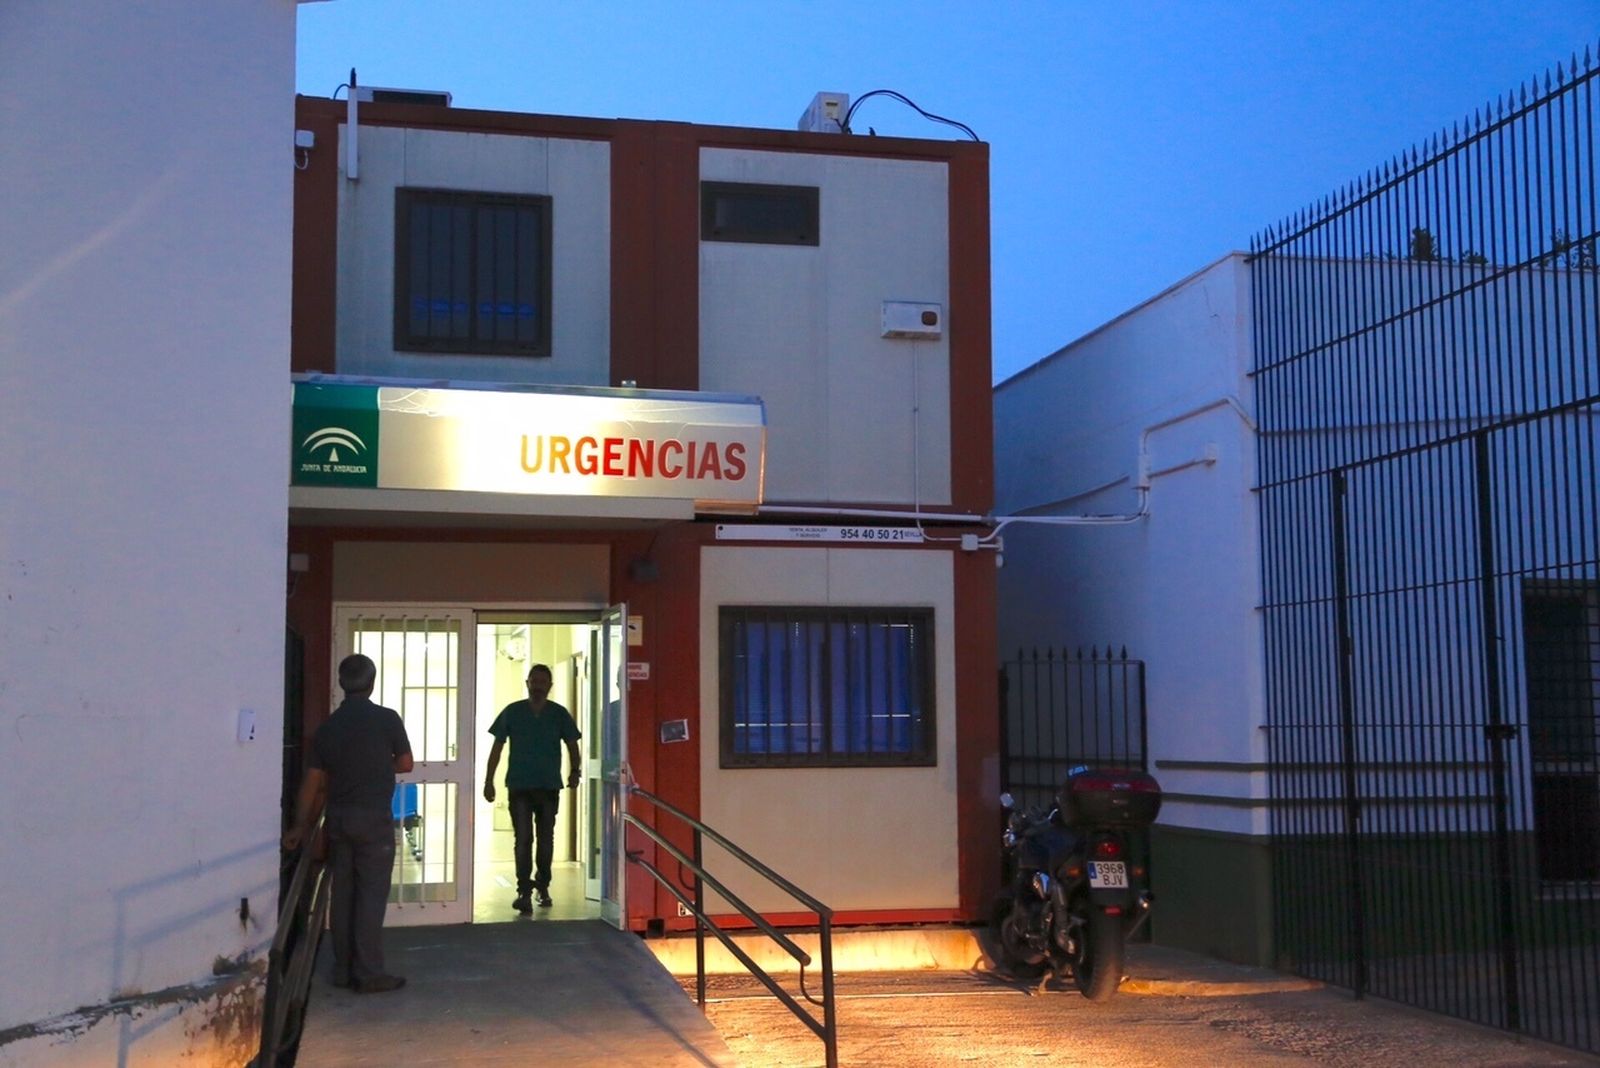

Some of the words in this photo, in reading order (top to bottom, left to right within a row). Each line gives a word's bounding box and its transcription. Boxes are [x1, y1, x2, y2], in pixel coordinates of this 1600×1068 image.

[520, 434, 747, 481] URGENCIAS
[301, 463, 321, 472] JUNTA
[322, 464, 331, 473] DE
[840, 528, 859, 539] 954
[862, 529, 875, 539] 40
[878, 529, 890, 540] 50
[892, 529, 904, 540] 21
[1096, 862, 1125, 875] 3968
[1102, 874, 1123, 886] BJV
